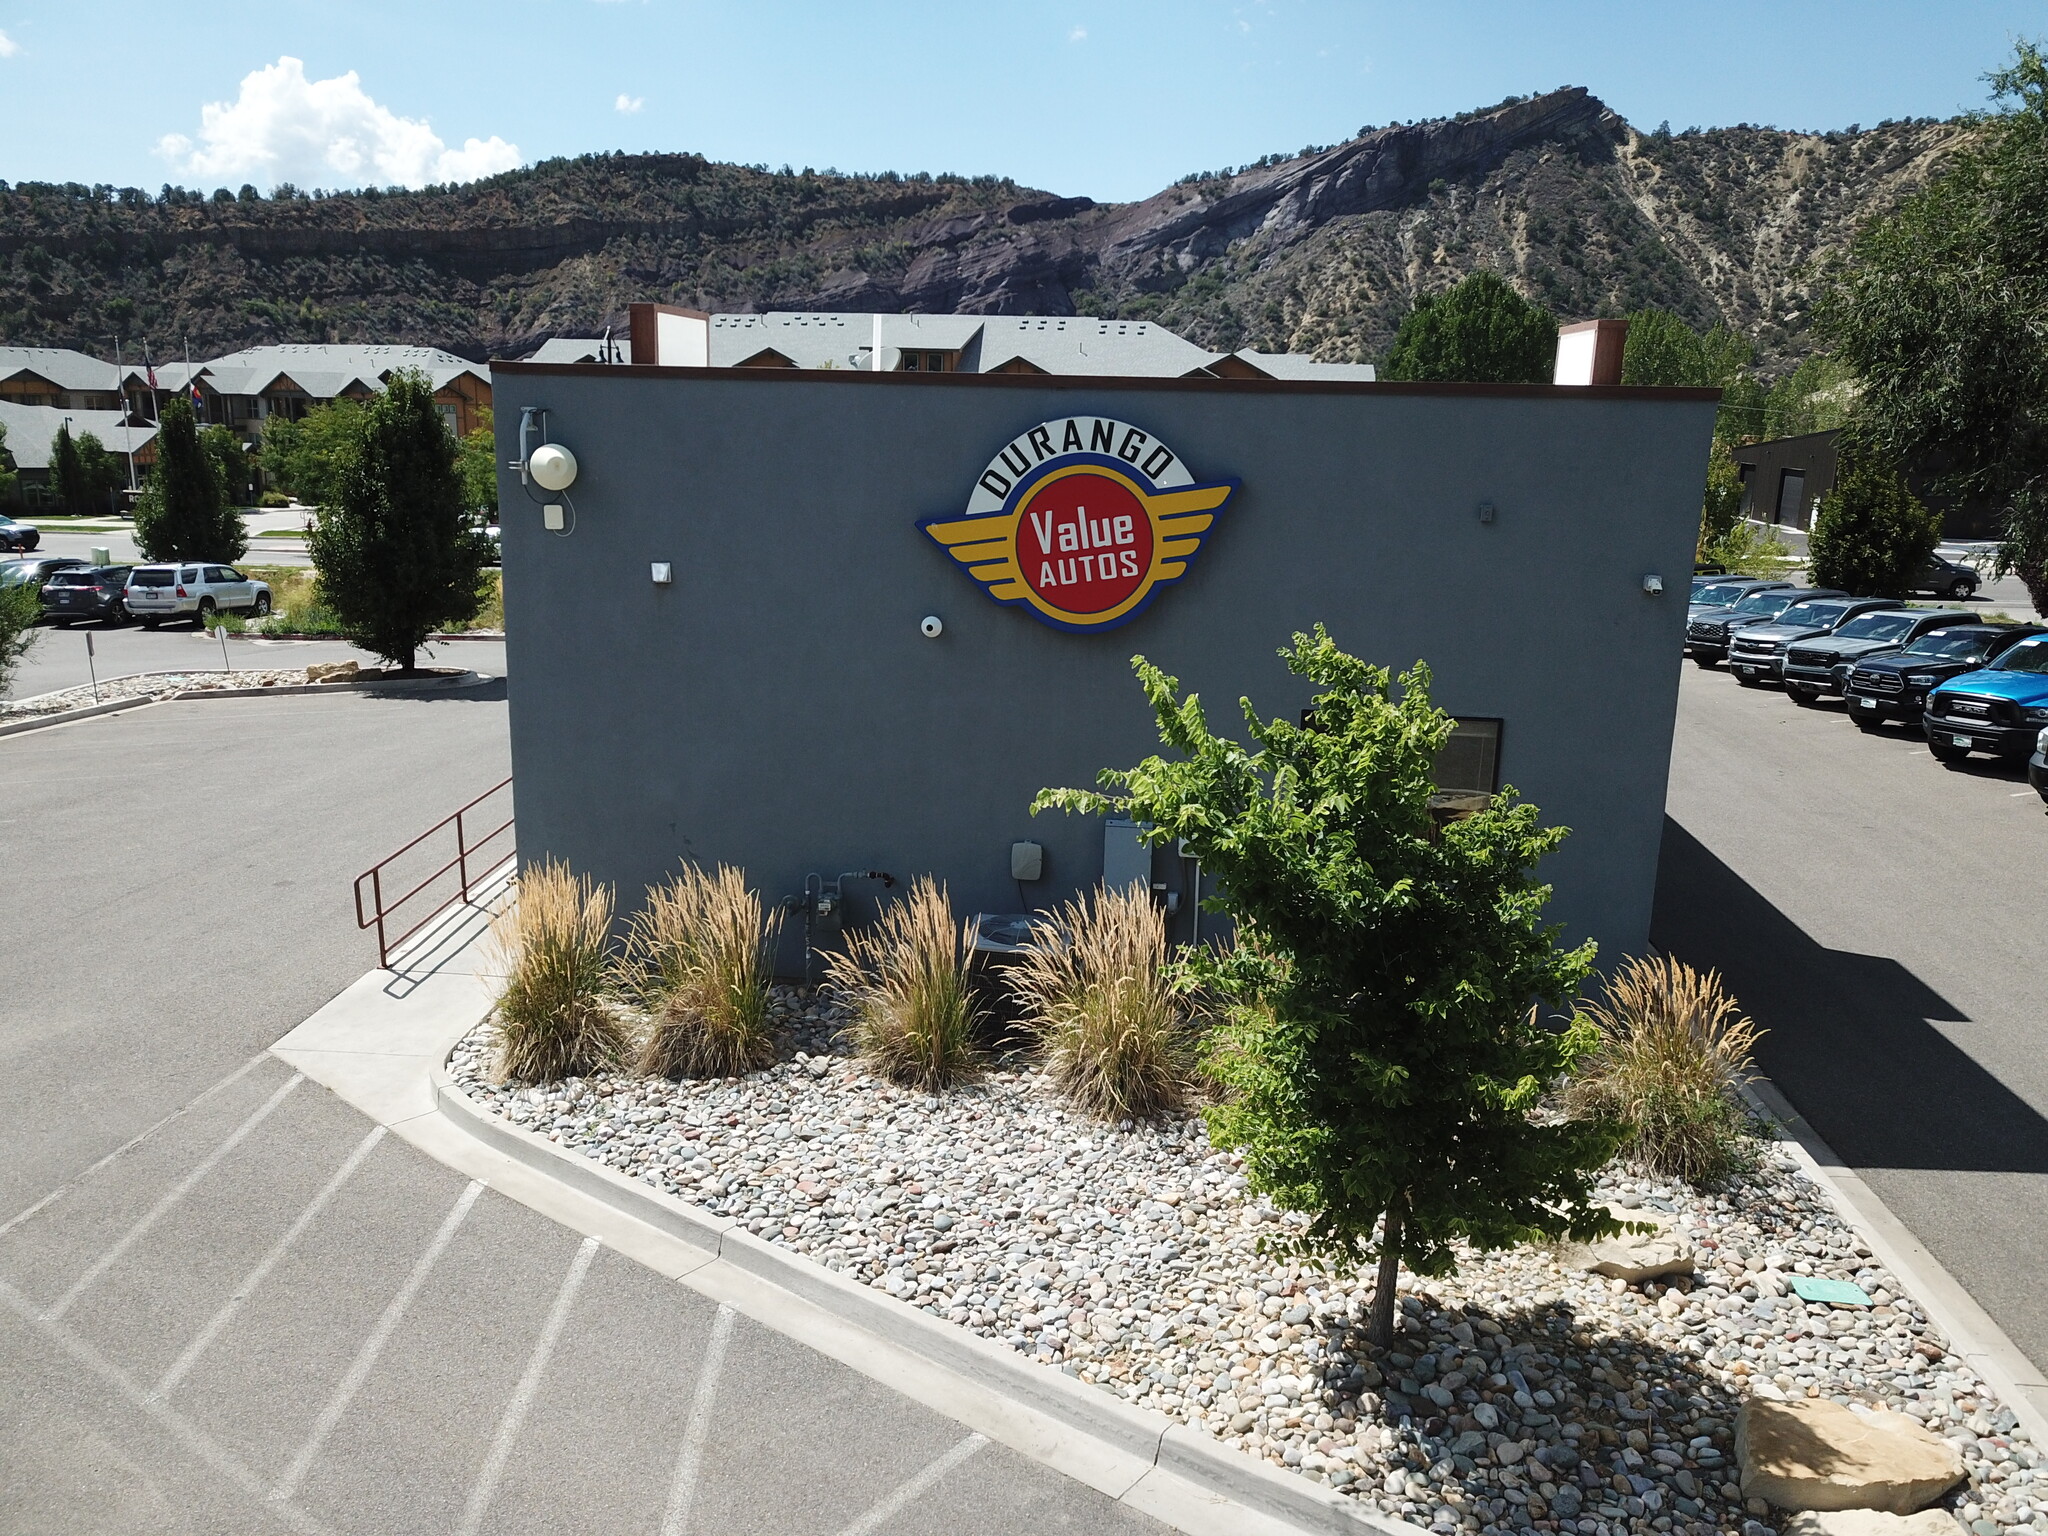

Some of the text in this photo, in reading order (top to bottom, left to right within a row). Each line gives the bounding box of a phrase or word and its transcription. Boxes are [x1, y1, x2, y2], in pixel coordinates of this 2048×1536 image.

[979, 419, 1174, 500] DURANGO
[1030, 506, 1135, 555] Value
[1039, 550, 1139, 588] AUTOS
